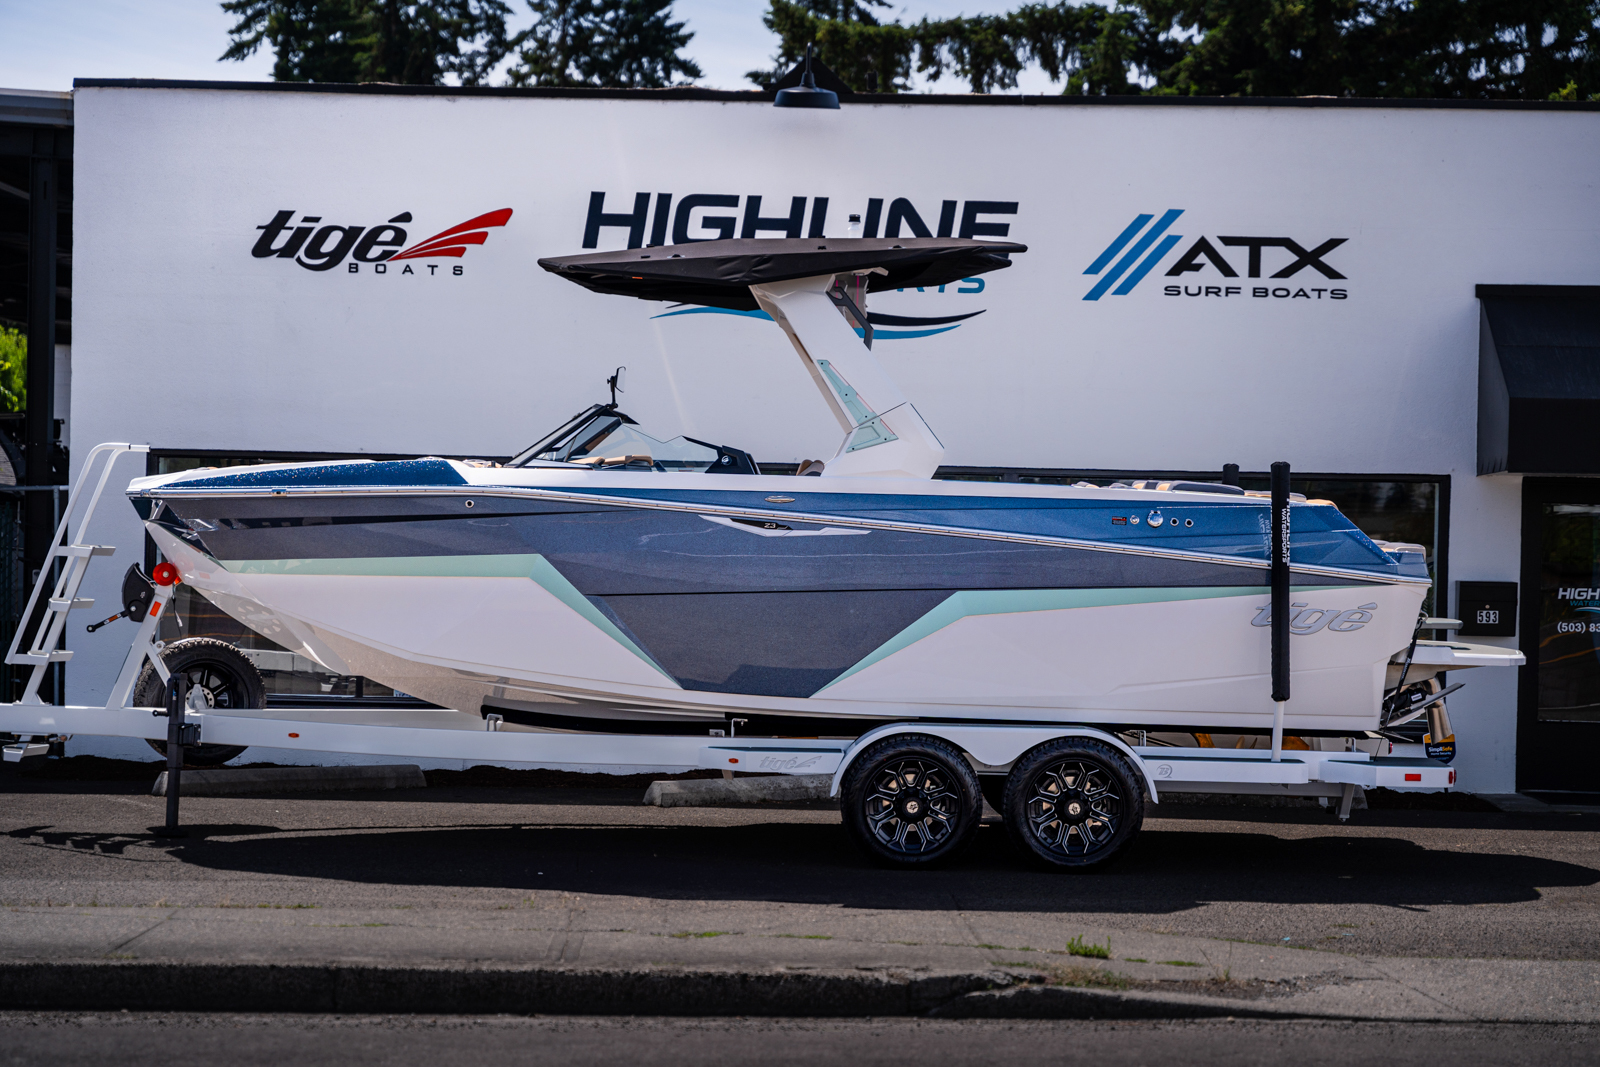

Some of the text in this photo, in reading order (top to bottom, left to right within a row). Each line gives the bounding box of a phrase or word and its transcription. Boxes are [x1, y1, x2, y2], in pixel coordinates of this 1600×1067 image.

[1164, 235, 1350, 279] ATX
[348, 262, 464, 276] BOATS
[1164, 285, 1348, 300] SURF BOATS
[1478, 611, 1498, 623] 593
[1557, 621, 1586, 633] (503)
